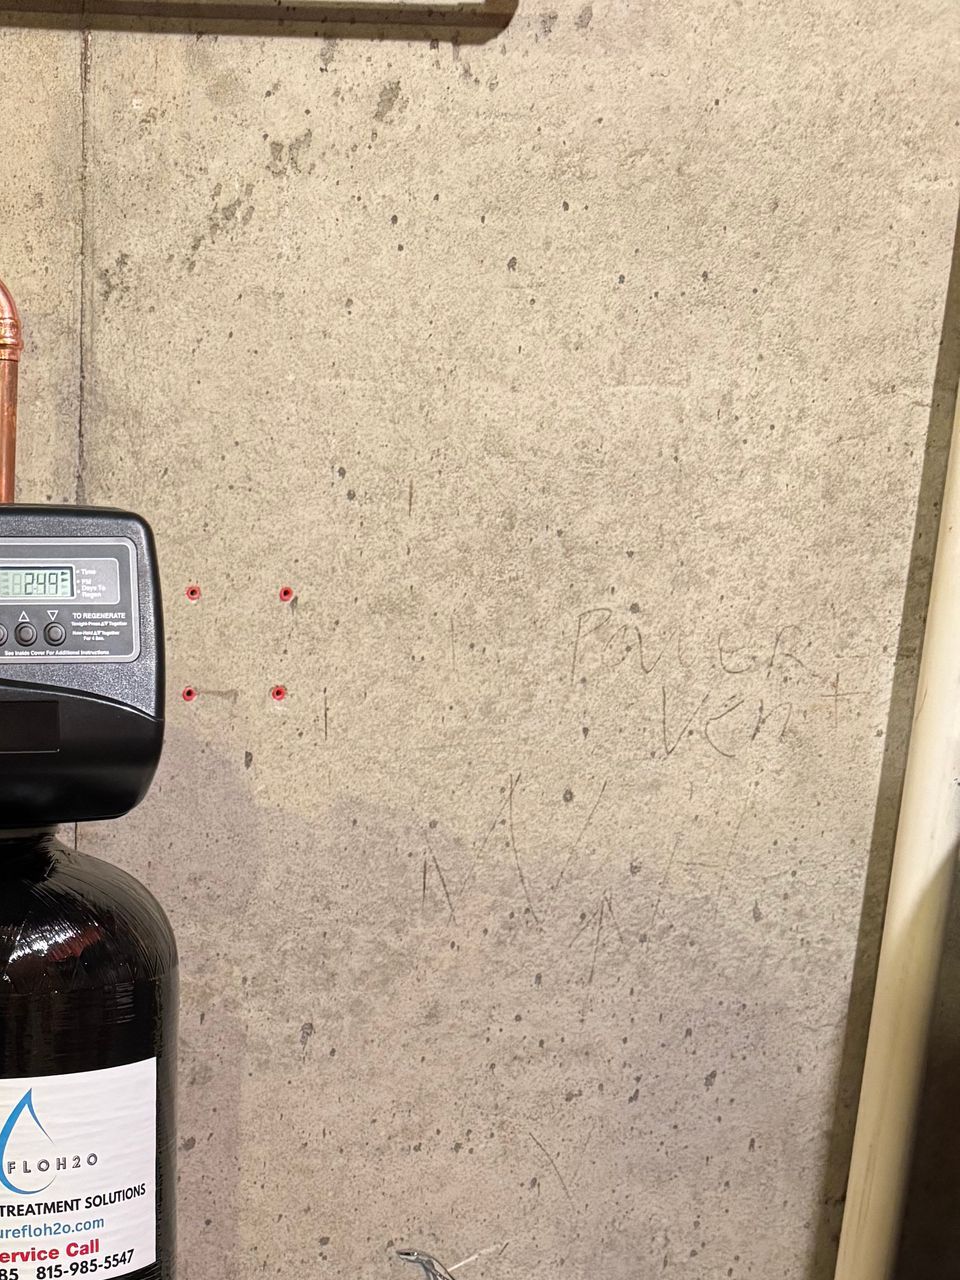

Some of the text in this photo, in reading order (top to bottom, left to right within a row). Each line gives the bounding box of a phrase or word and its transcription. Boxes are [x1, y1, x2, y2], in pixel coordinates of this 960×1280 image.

[81, 568, 97, 576] Time
[81, 585, 97, 593] Days
[72, 612, 127, 620] TO REGENERATE
[84, 1183, 146, 1209] SOLUTIONS
[65, 1238, 100, 1258] Call
[35, 1248, 136, 1280] 815-985-5547
